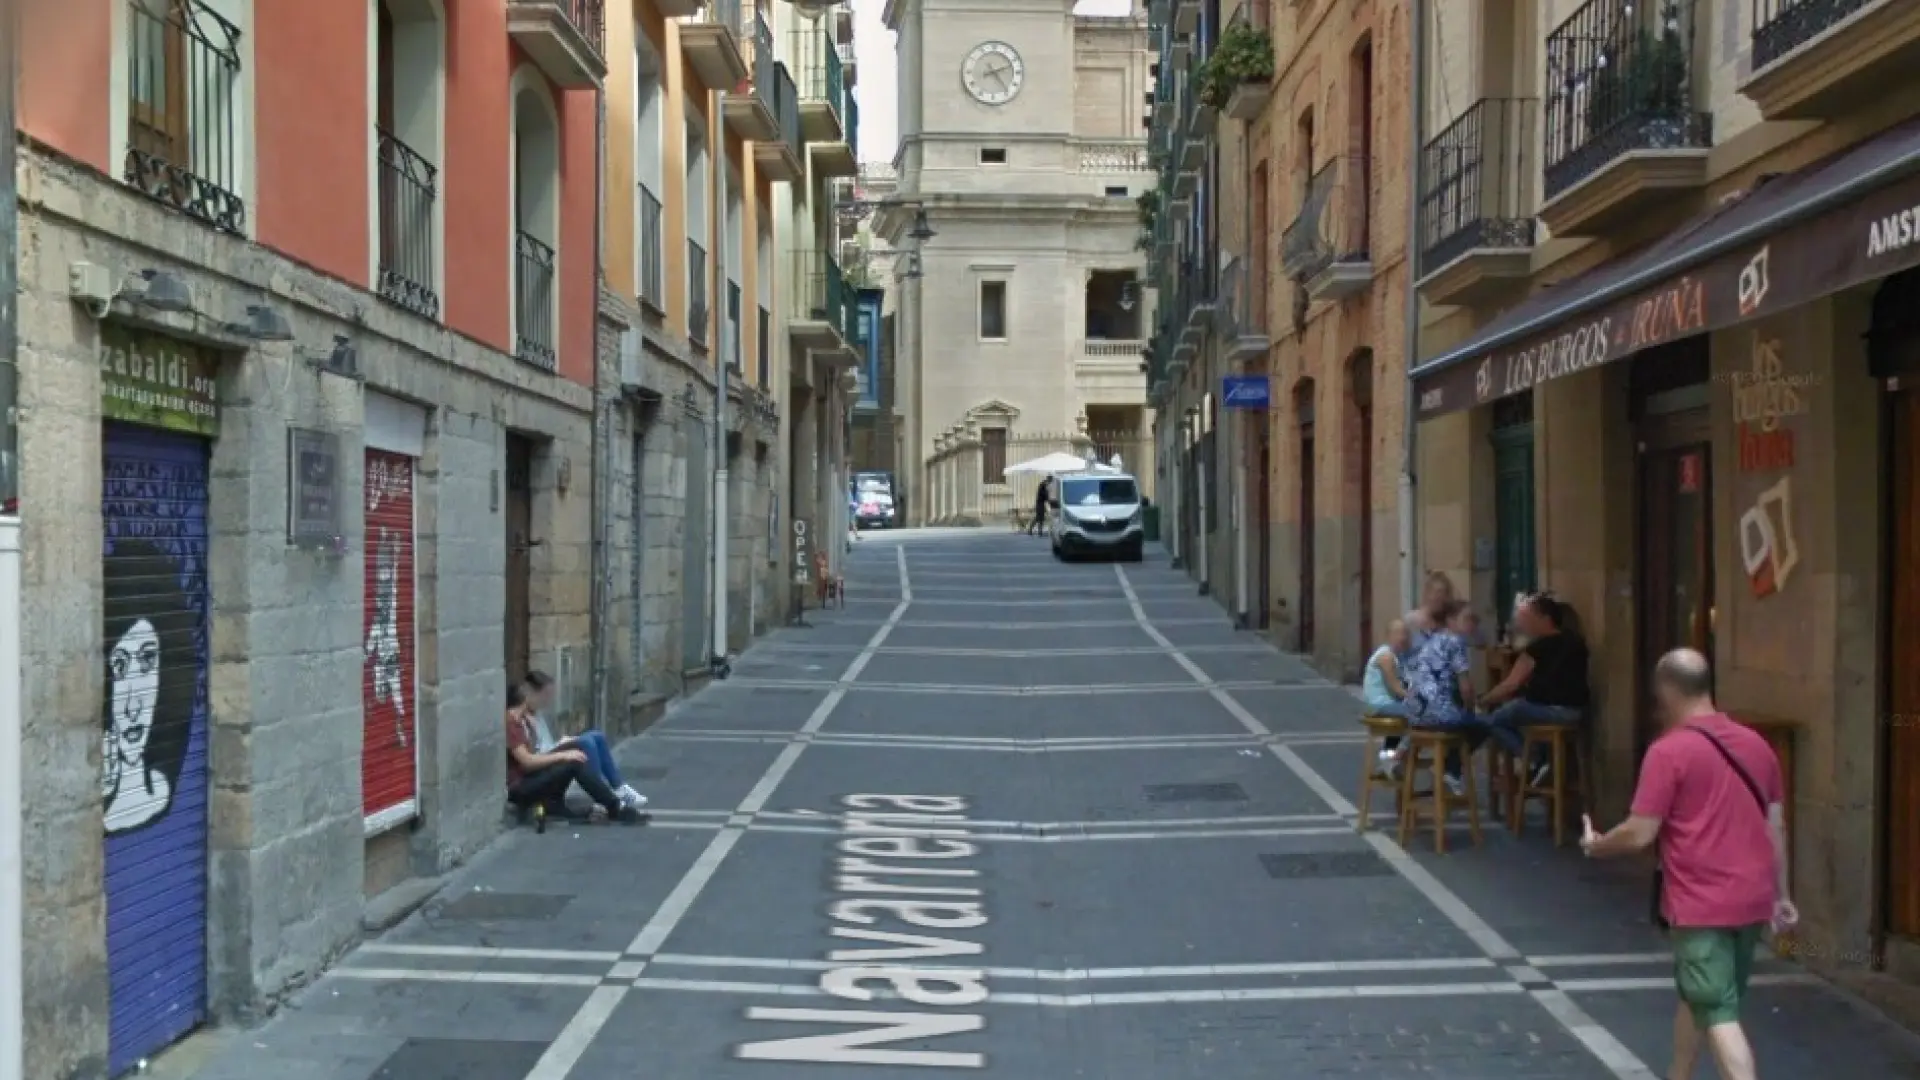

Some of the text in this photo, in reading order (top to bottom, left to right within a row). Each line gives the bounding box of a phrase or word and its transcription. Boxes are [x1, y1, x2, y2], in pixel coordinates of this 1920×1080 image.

[1504, 349, 1535, 394] LOS
[1536, 316, 1611, 384] BURGOS
[793, 519, 808, 584] OPEN
